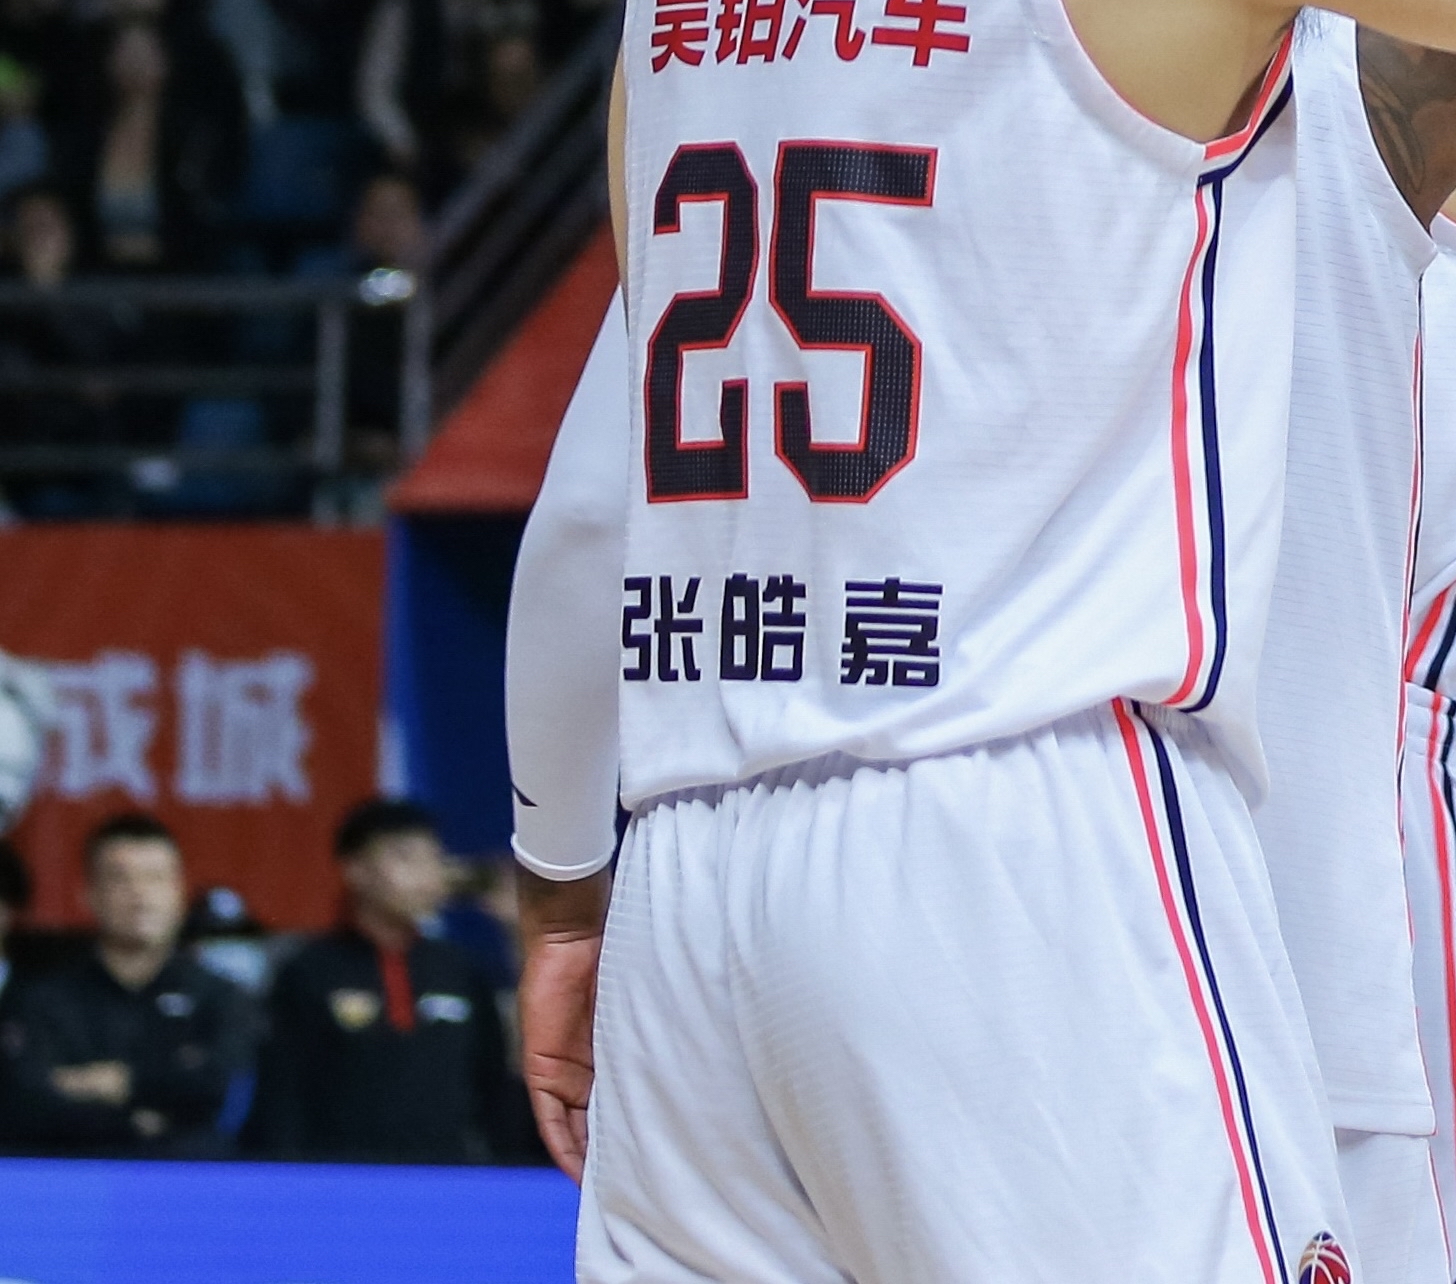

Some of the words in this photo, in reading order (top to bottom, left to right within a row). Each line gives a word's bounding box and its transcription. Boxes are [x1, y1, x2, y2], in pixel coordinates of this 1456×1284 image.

[644, 139, 938, 504] 25
[621, 573, 943, 687] 张皓嘉
